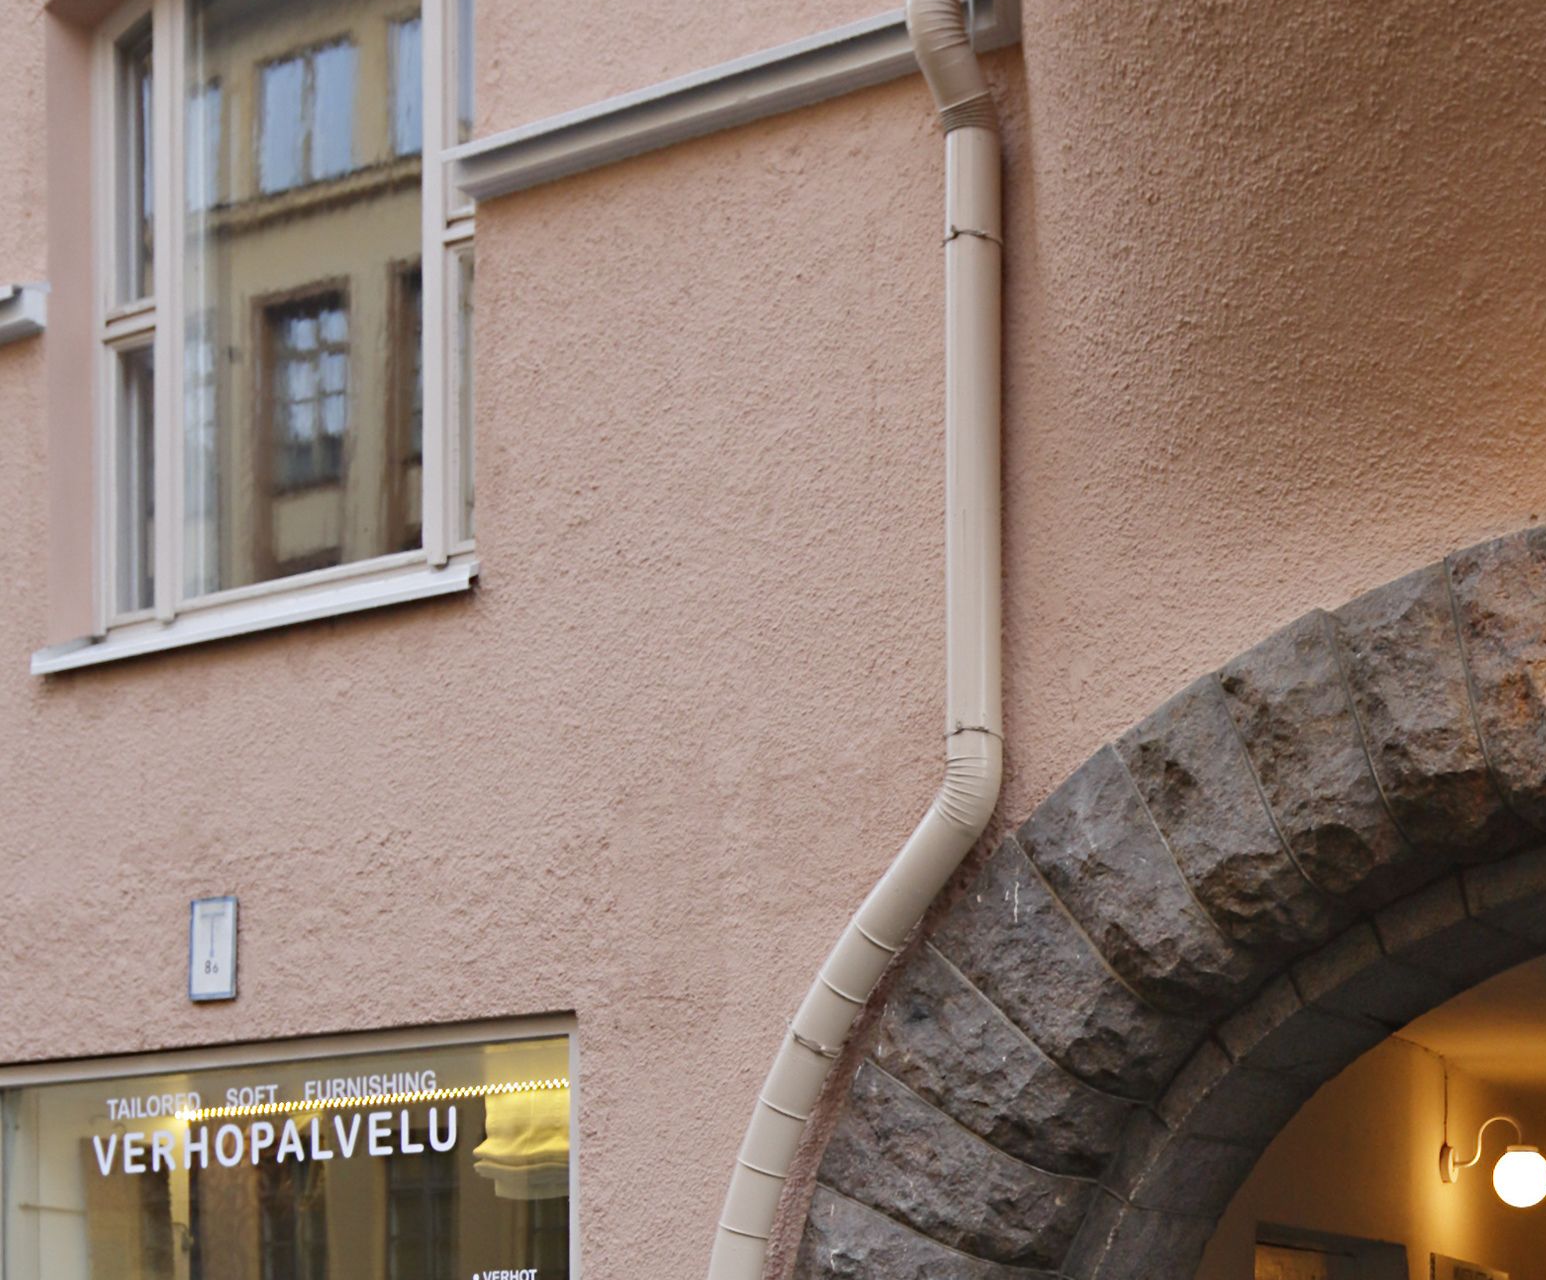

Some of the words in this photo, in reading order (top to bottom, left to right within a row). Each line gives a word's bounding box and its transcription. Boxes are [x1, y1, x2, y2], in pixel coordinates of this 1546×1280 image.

[106, 1091, 201, 1121] TAILORED
[225, 1083, 279, 1110] SOFT
[304, 1070, 437, 1102] FURNISHING
[93, 1105, 458, 1177] VERHOPALVELU
